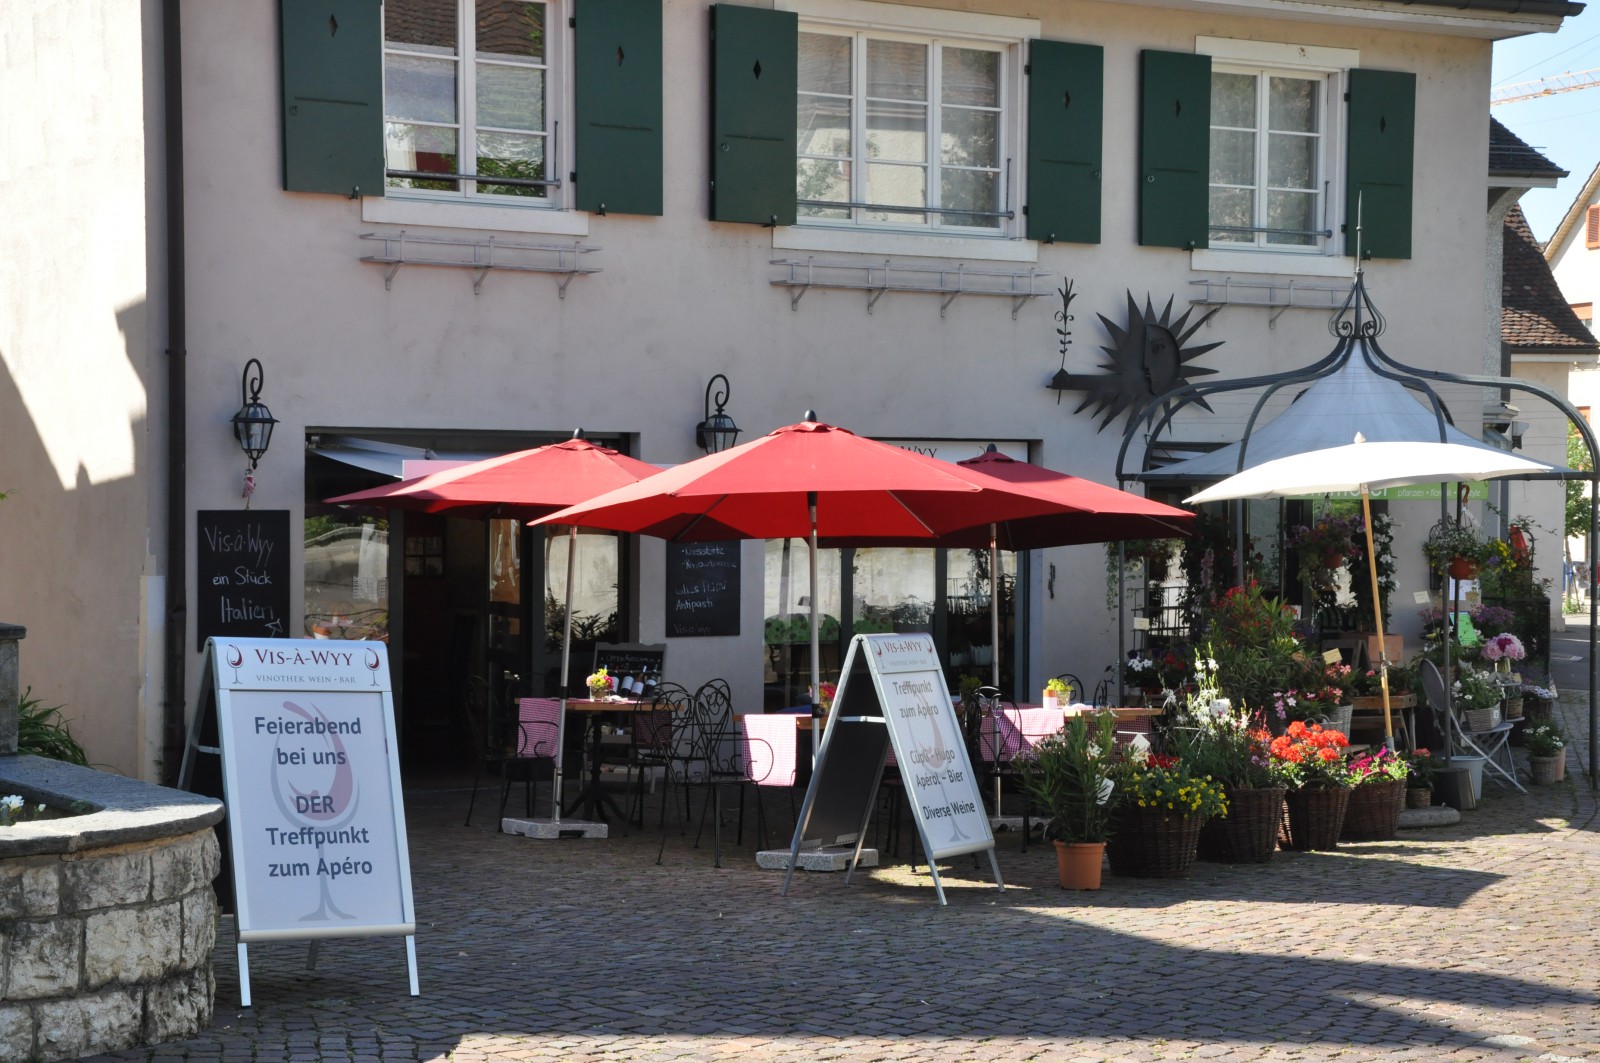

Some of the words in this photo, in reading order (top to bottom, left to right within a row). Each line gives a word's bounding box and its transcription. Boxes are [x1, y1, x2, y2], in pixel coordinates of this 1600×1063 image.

[1397, 488, 1424, 499] pflanzen
[213, 573, 230, 585] ein
[235, 565, 273, 585] Stück
[221, 595, 274, 623] Italien
[256, 674, 305, 683] VINOTHEK
[308, 676, 331, 684] WEIN
[339, 676, 357, 684] BAR
[892, 680, 933, 697] Treffpunkt
[899, 706, 916, 718] zum
[254, 716, 362, 735] Feierabend
[277, 747, 307, 766] bei
[313, 750, 346, 765] uns
[934, 747, 956, 763] Hugo
[947, 769, 964, 783] Bier
[296, 795, 335, 814] DER
[923, 805, 952, 820] Diverse
[950, 801, 976, 815] Weine
[265, 826, 370, 849] Treffpunkt
[268, 862, 310, 878] zum
[316, 855, 373, 880] Apéro
